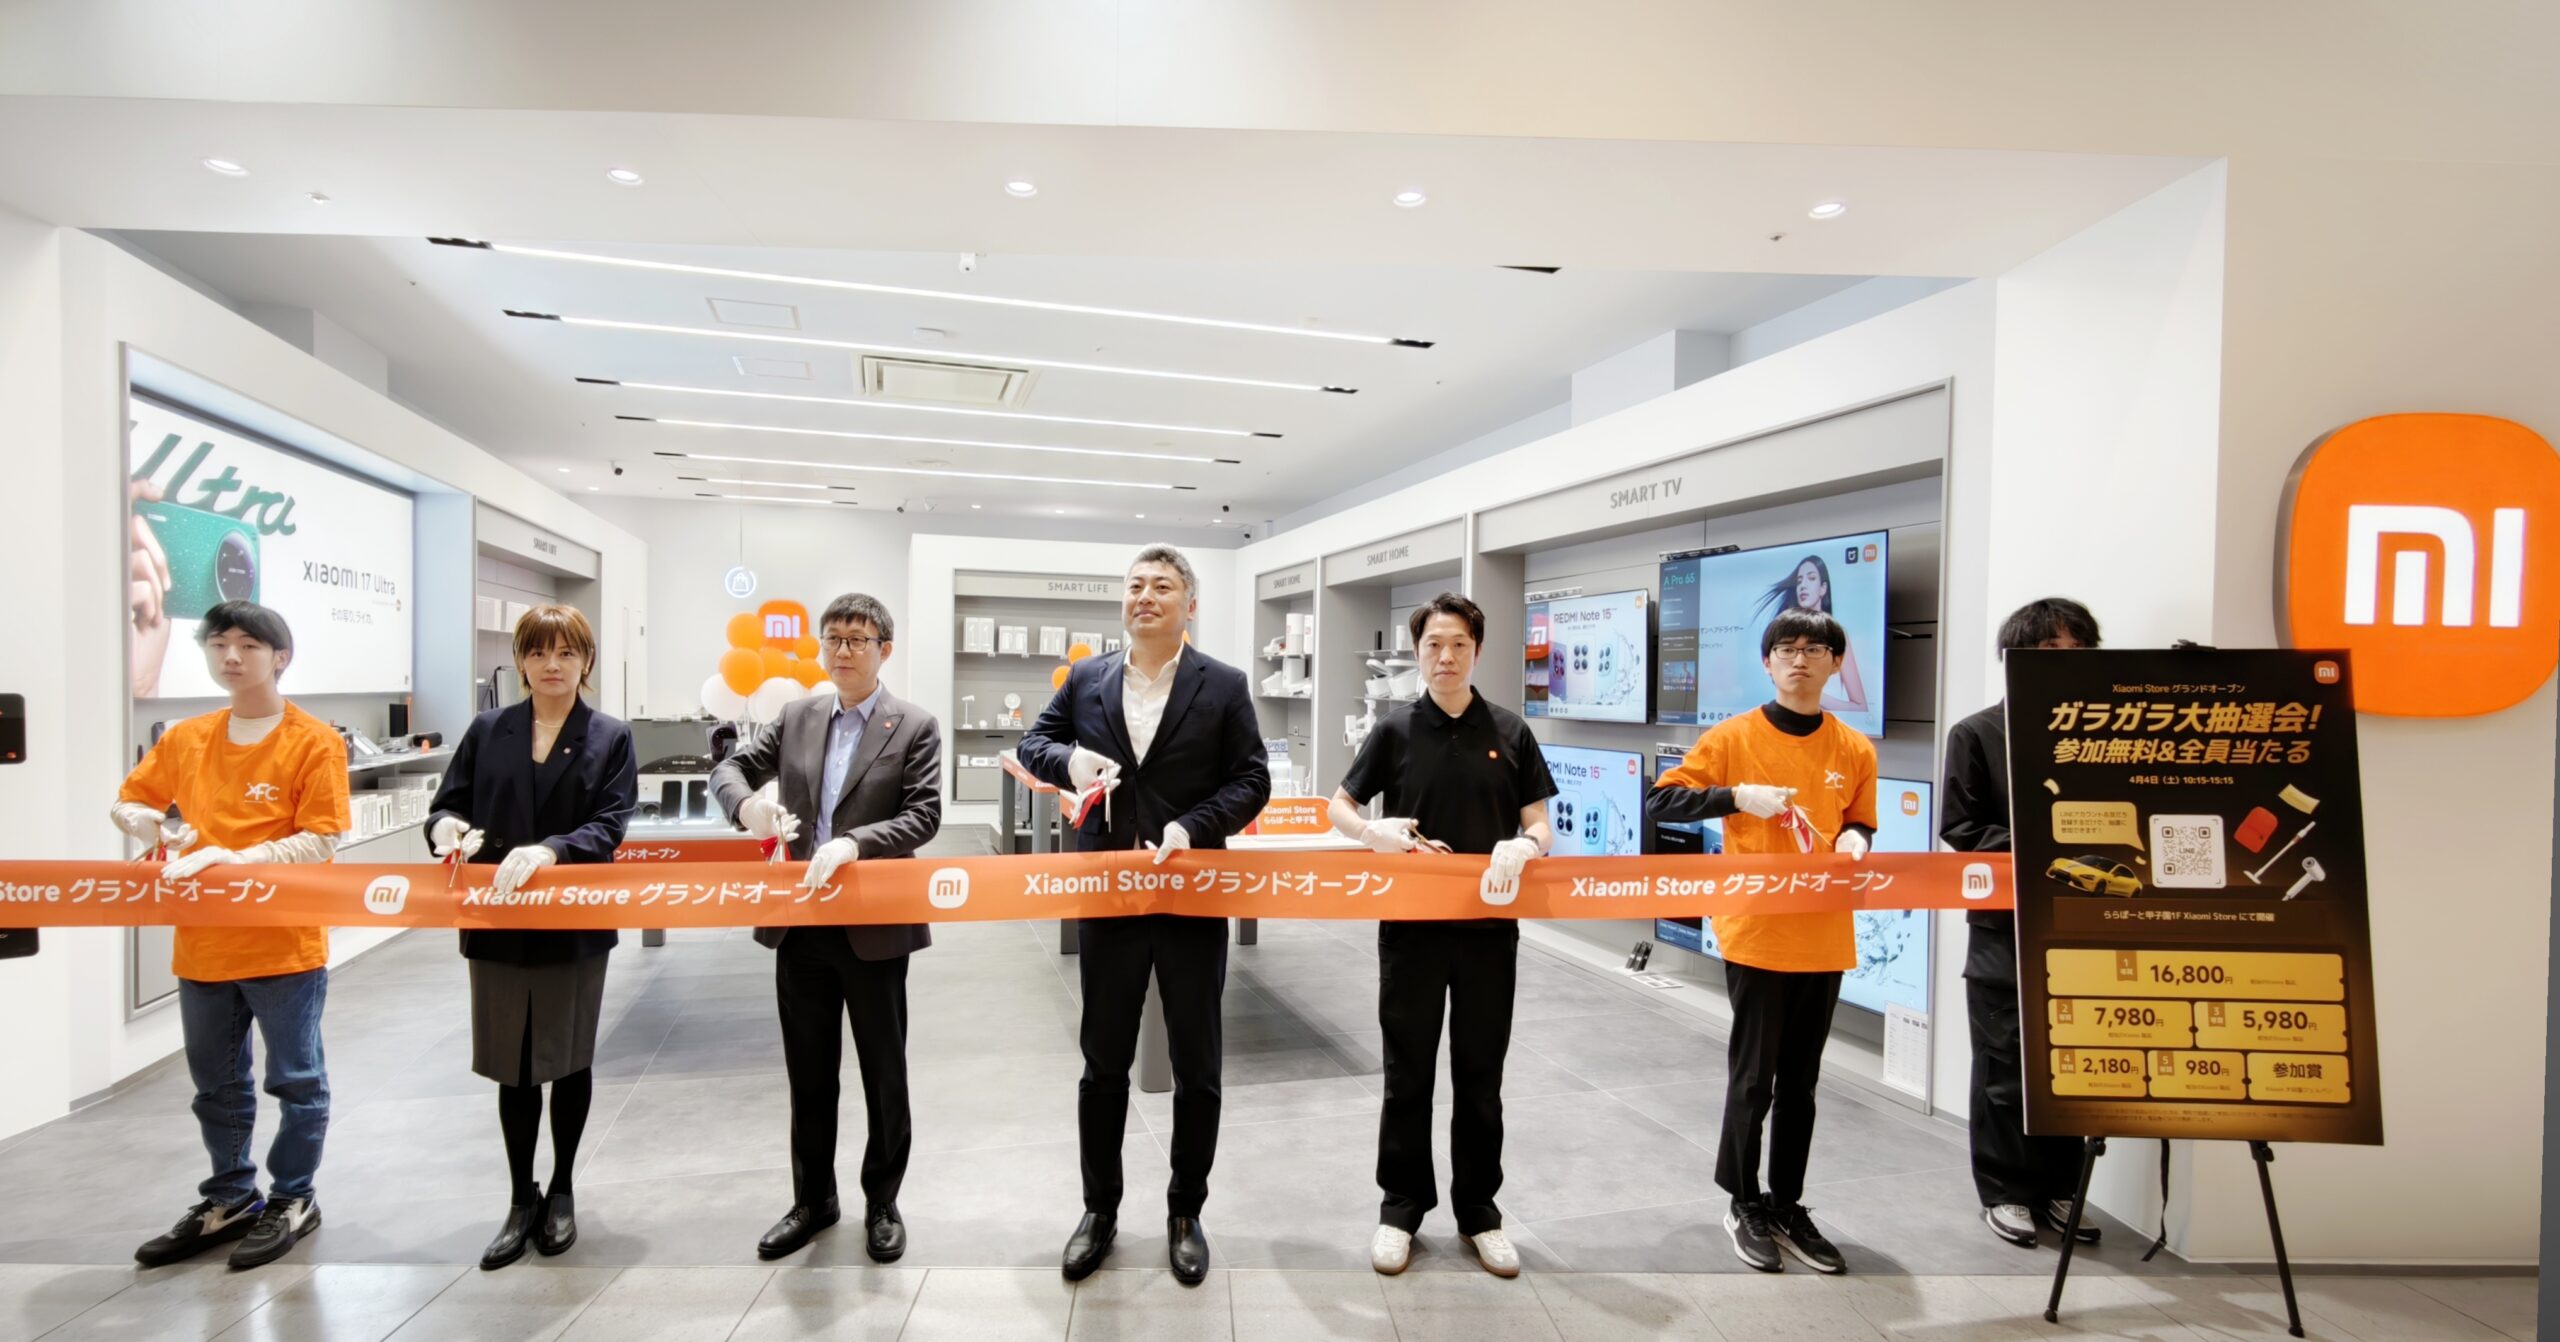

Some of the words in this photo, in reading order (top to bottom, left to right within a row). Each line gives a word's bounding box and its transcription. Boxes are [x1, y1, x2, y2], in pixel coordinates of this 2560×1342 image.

[1610, 483, 1658, 509] SMART
[1662, 477, 1682, 498] TV
[1367, 551, 1387, 566] SMART
[1389, 545, 1409, 560] HOME
[361, 573, 371, 591] 17
[374, 574, 396, 595] Ultra
[1048, 582, 1084, 592] SMART
[1088, 583, 1109, 593] LIFE
[1273, 577, 1287, 589] SMART
[1671, 575, 1683, 585] Pro
[1554, 611, 1578, 624] REDMI
[1580, 610, 1600, 621] Note
[1602, 608, 1612, 620] 15
[2112, 684, 2143, 693] Xiaomi
[2145, 684, 2169, 693] Store
[2171, 684, 2246, 694] グランドオープン
[2053, 738, 2312, 765] 参加無料&全員当たる
[1564, 763, 1587, 777] Note
[1590, 766, 1600, 779] 15
[244, 782, 280, 801] XFC
[1294, 805, 1317, 815] Store
[69, 877, 278, 904] グランドオープン
[1024, 869, 1109, 895] Xiaomi
[1117, 869, 1186, 892] Store
[1193, 869, 1395, 896] グランドオープン
[1570, 875, 1648, 898] Xiaomi
[1655, 875, 1716, 896] Store
[1723, 872, 1895, 895] グランドオープン
[462, 885, 553, 907] Xiaomi
[559, 884, 630, 907] Store
[2183, 912, 2212, 921] Xiaomi
[2213, 912, 2237, 921] Store
[2272, 1062, 2323, 1079] 参加賞
